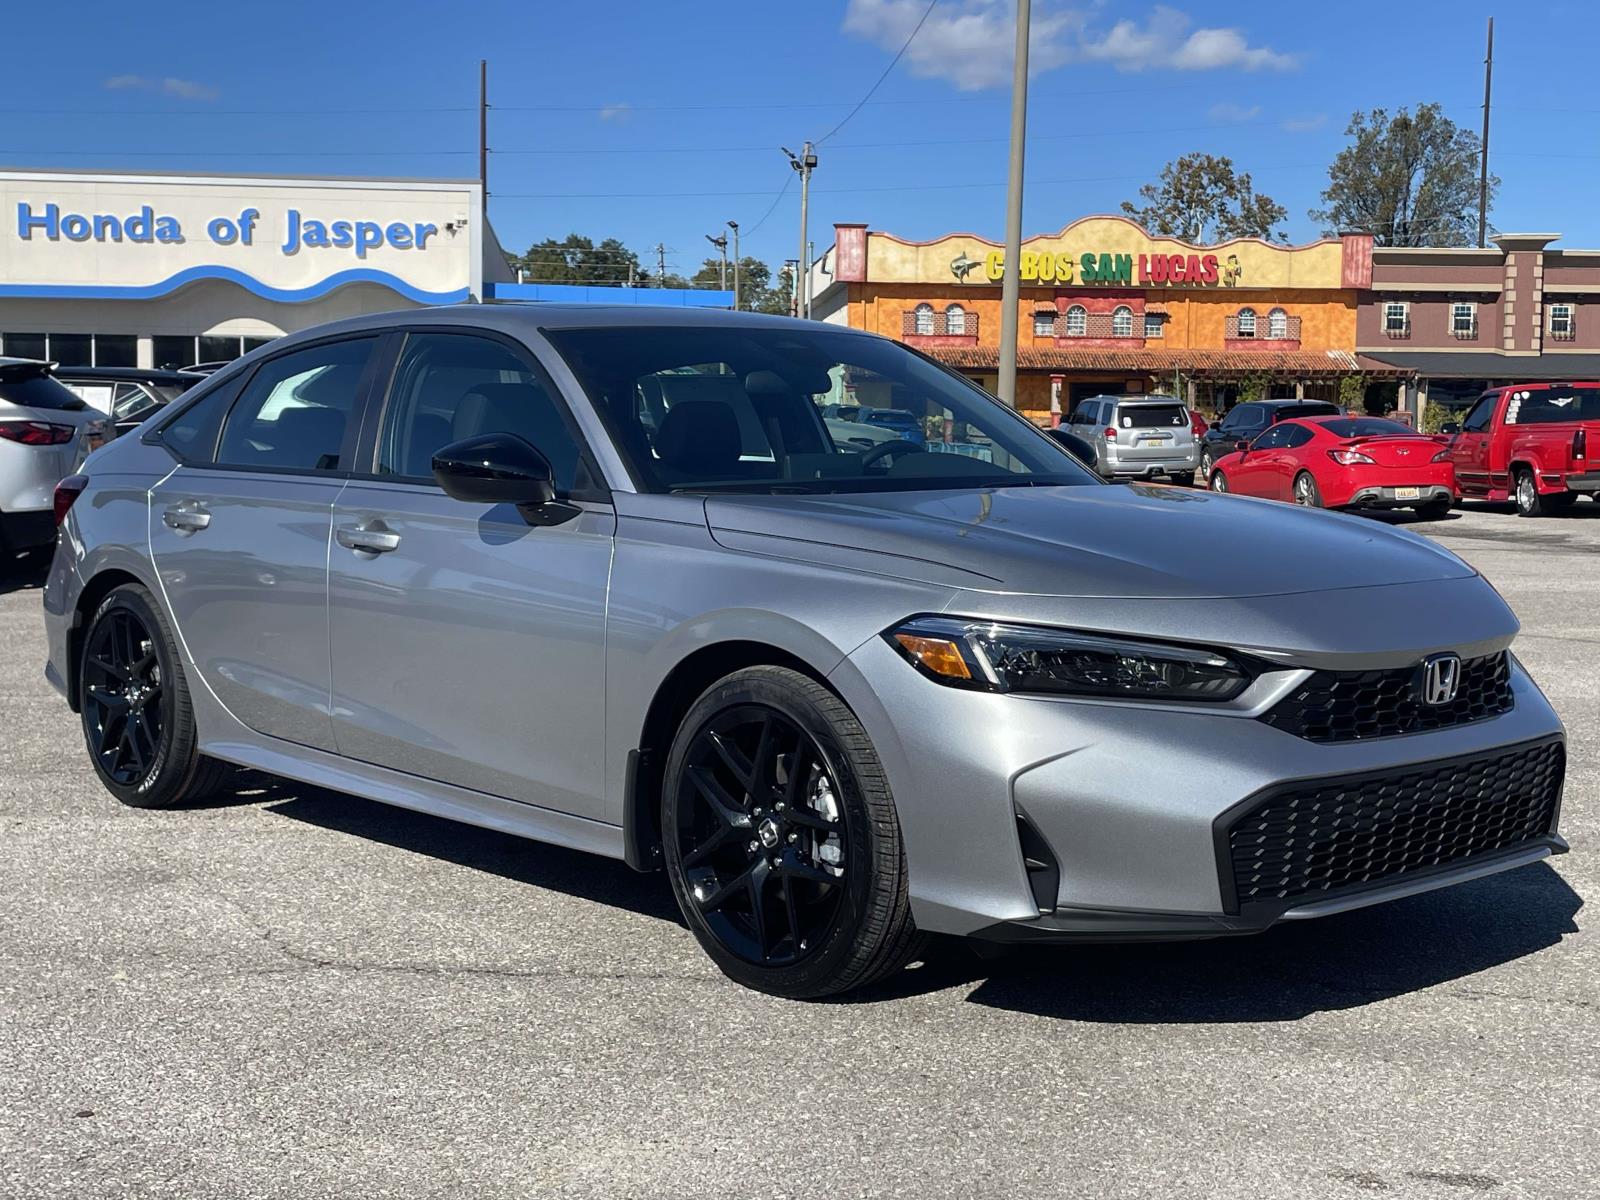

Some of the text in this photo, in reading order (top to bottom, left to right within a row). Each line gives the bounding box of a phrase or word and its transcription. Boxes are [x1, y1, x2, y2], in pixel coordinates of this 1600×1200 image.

[17, 202, 437, 259] Honda of Jasper
[985, 251, 1219, 285] CBOS SAN LUCAS
